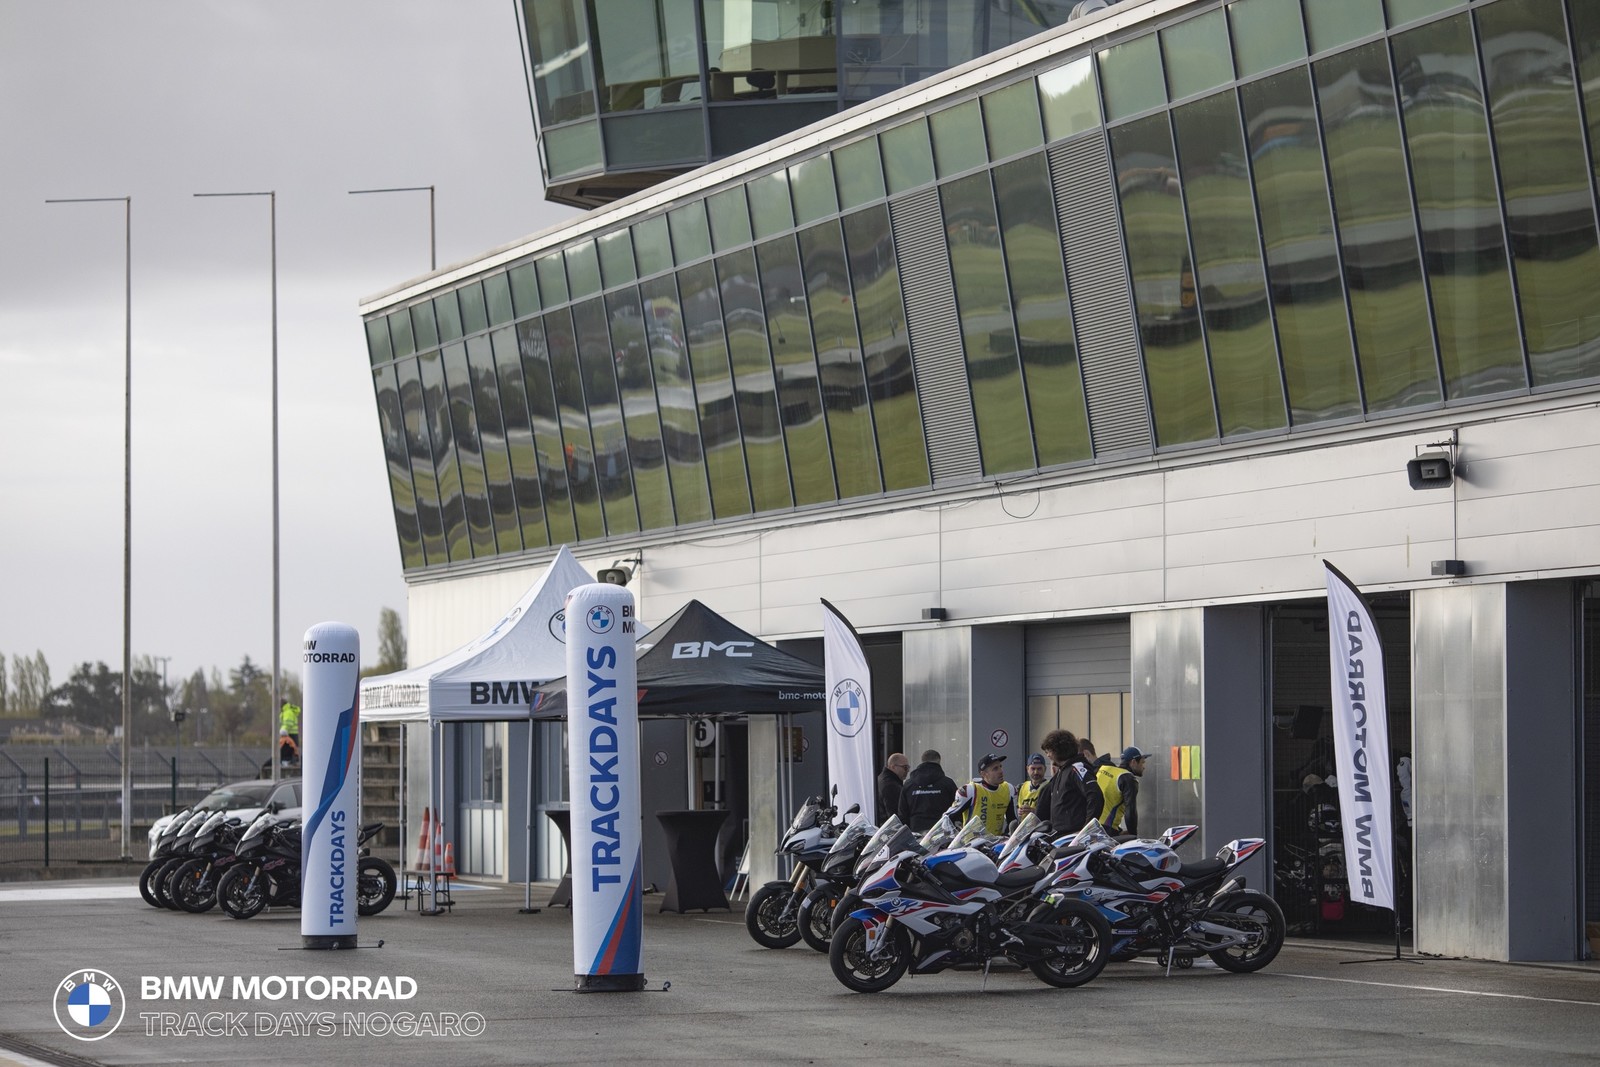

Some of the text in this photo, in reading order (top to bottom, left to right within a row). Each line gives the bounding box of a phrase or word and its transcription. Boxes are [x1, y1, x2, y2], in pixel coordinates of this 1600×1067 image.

[590, 606, 611, 615] BMW
[672, 641, 754, 660] BMC
[586, 645, 622, 893] TRACKDAYS
[330, 810, 346, 928] TRACKDAYS
